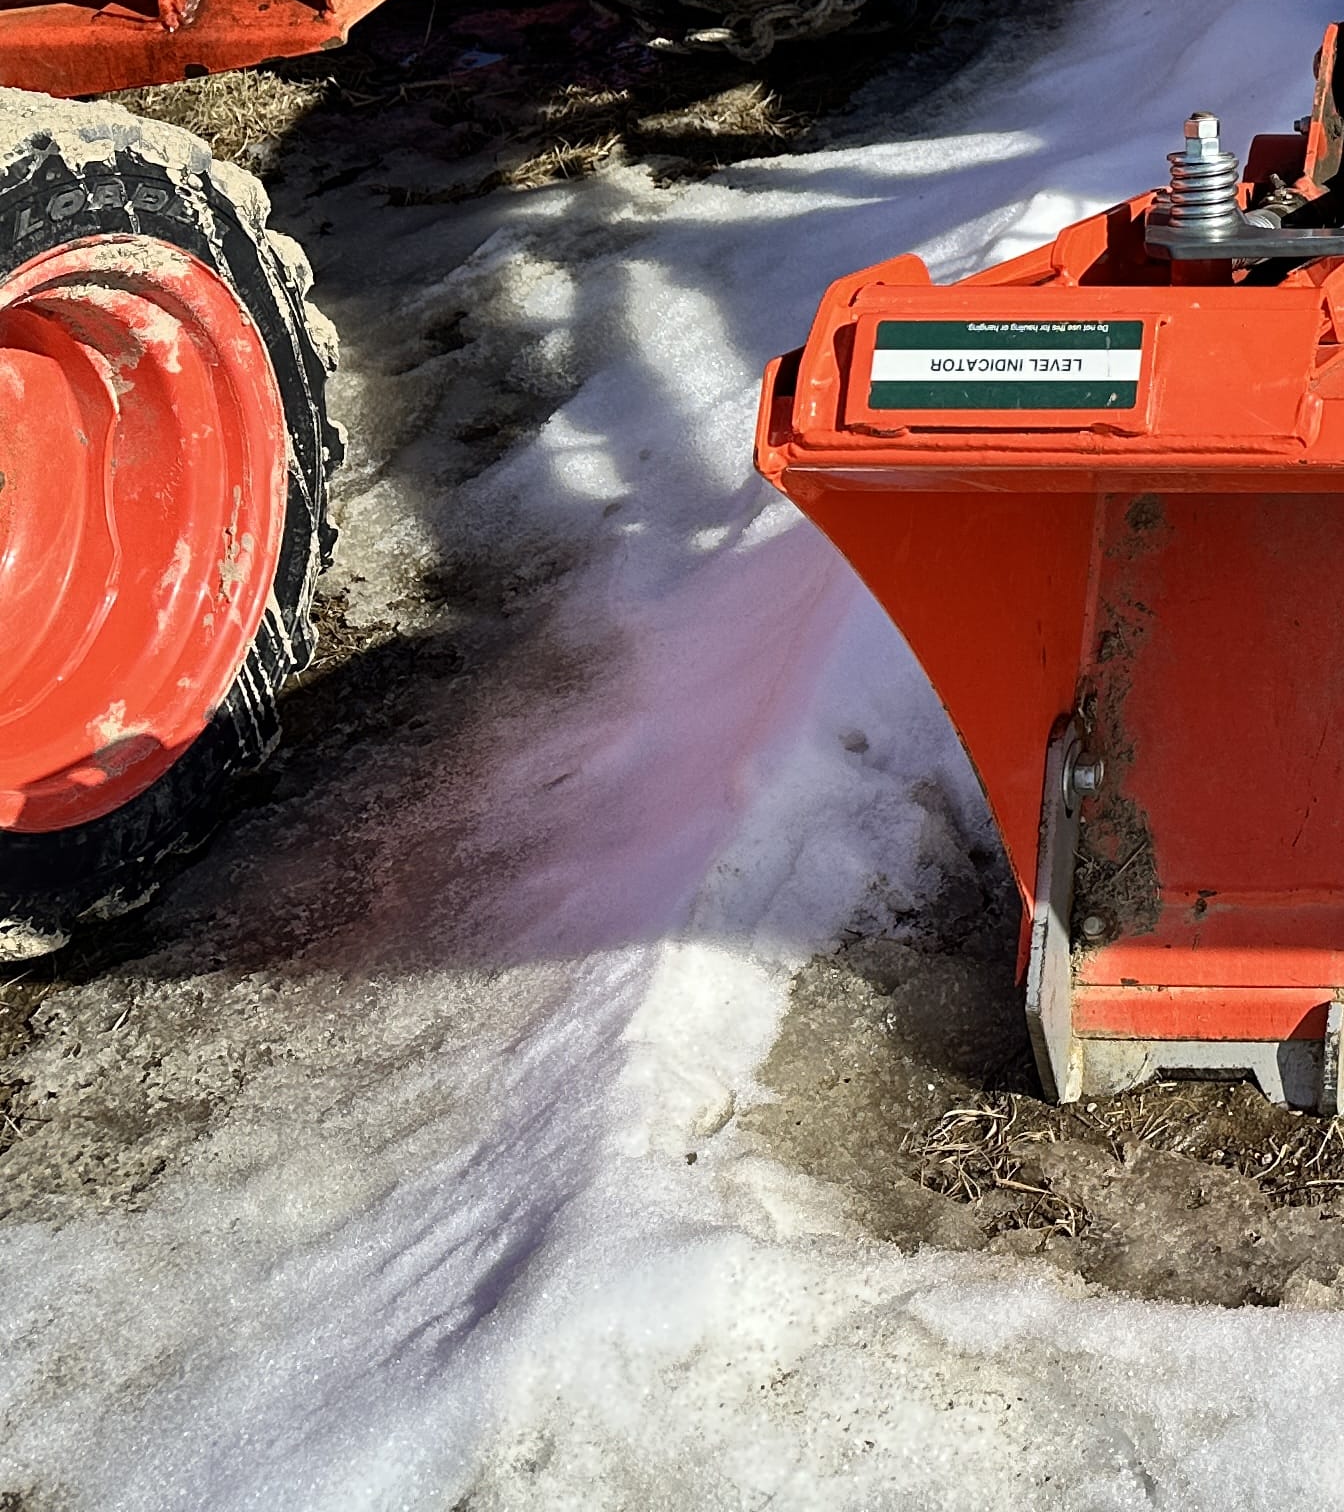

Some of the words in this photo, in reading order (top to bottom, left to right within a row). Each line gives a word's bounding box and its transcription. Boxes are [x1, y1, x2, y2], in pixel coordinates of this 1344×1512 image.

[1000, 323, 1009, 333] or
[1039, 323, 1050, 333] for
[1051, 323, 1066, 333] this
[1067, 323, 1082, 333] use
[1082, 323, 1096, 333] not
[1096, 323, 1109, 333] Do
[930, 358, 1024, 372] INDICATOR
[1029, 358, 1082, 372] LEVEL
